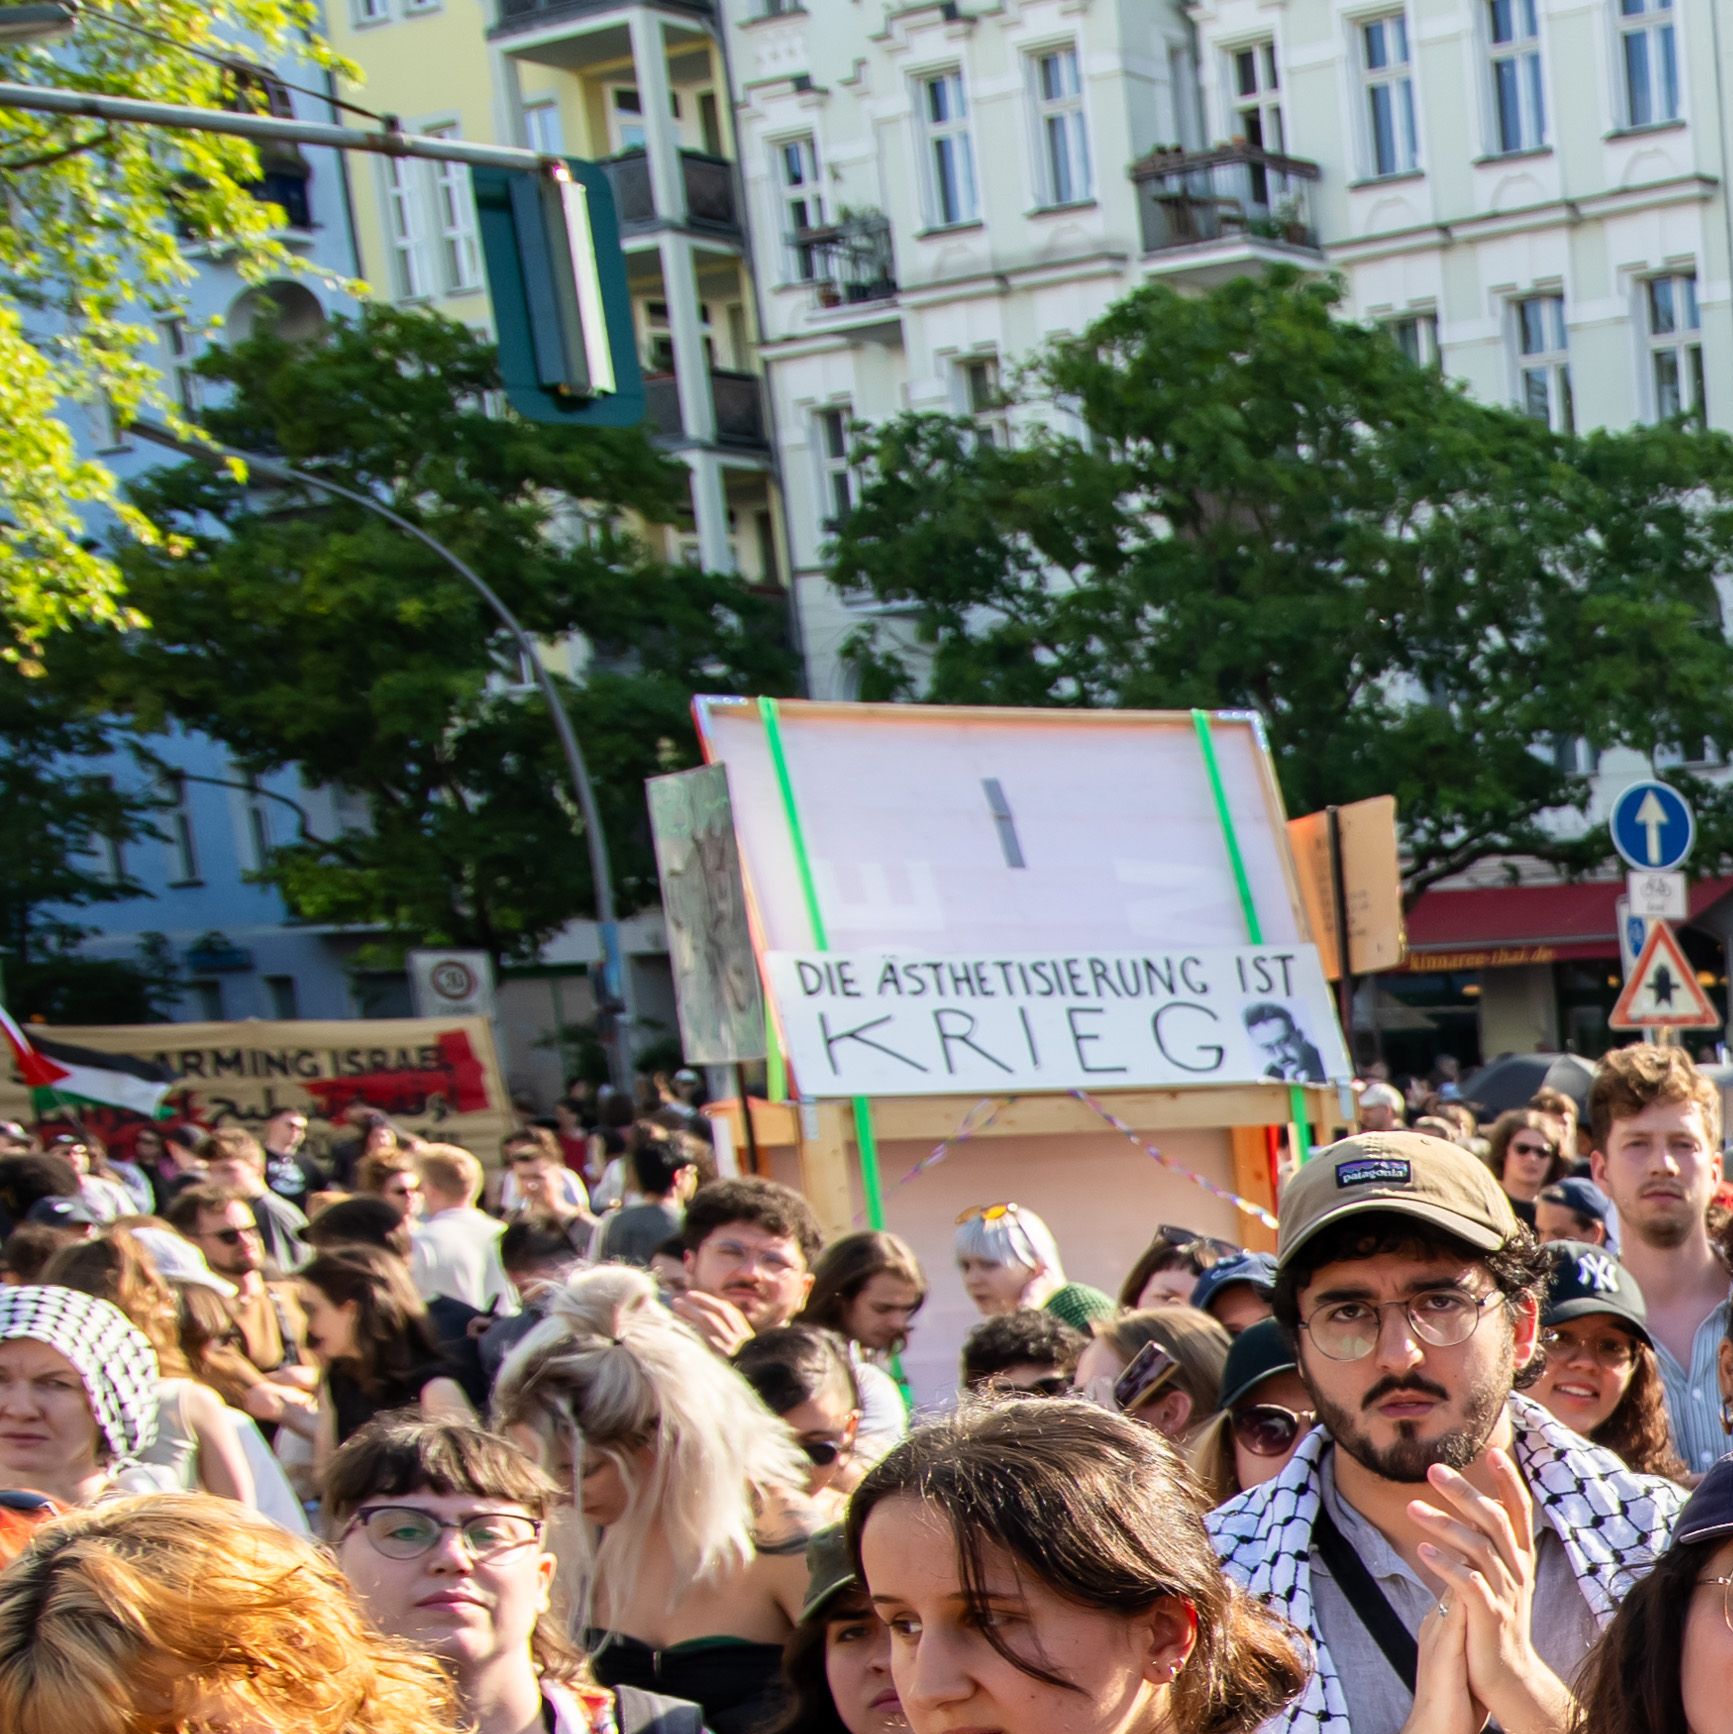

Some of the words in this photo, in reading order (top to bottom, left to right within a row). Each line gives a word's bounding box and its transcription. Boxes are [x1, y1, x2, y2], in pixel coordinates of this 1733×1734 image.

[796, 958, 861, 998] DIE
[877, 954, 1208, 998] ÄSTHETISIERUNG
[1235, 955, 1295, 998] IST
[818, 1001, 1224, 1074] KRIEG
[1342, 1168, 1404, 1183] patagonia
[1577, 1252, 1619, 1292] NY
